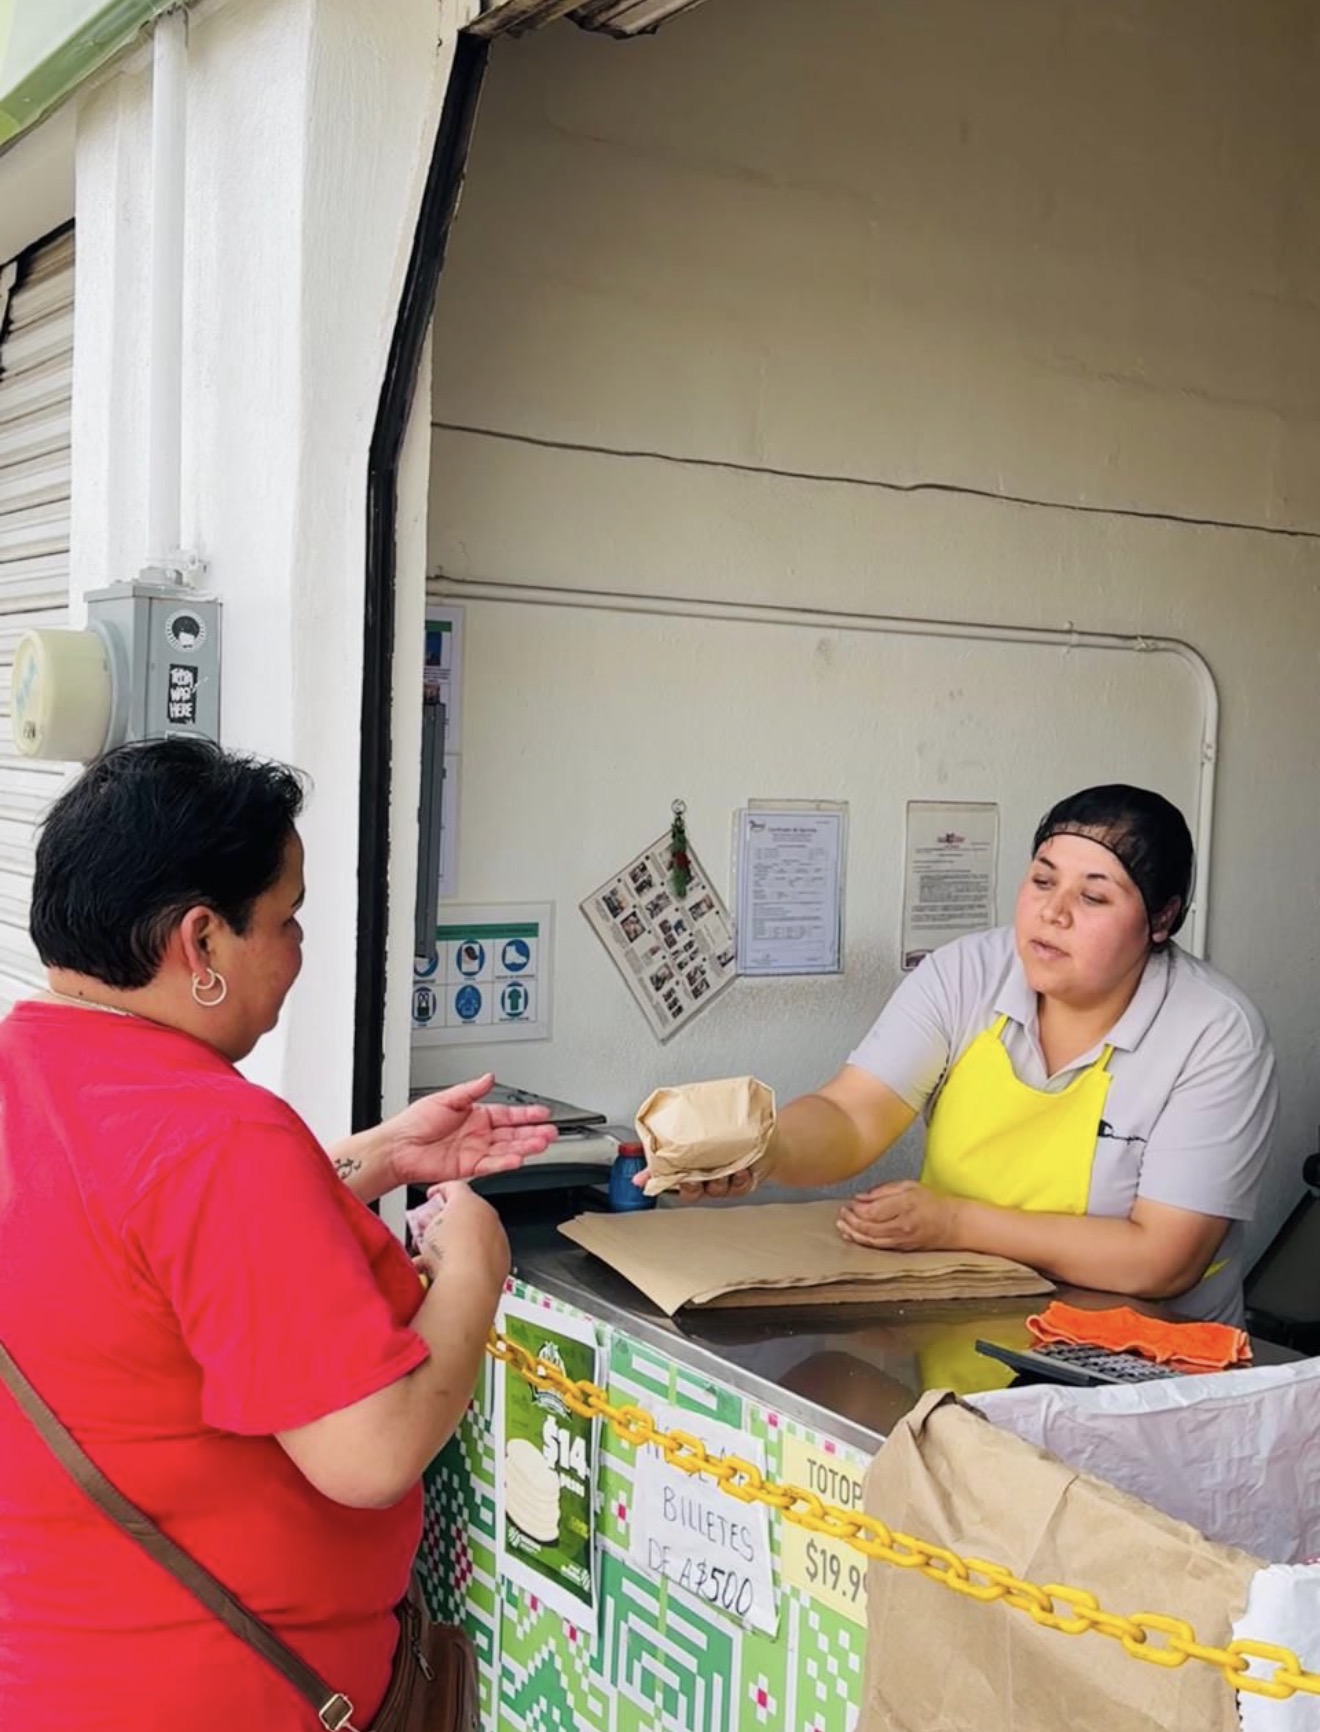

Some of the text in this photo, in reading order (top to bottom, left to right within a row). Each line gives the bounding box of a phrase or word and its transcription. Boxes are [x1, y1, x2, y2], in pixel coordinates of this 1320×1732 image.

[542, 1414, 591, 1481] $14
[807, 1457, 864, 1511] TOTOP
[663, 1485, 755, 1563] BILLETES
[805, 1537, 868, 1604] $19.9
